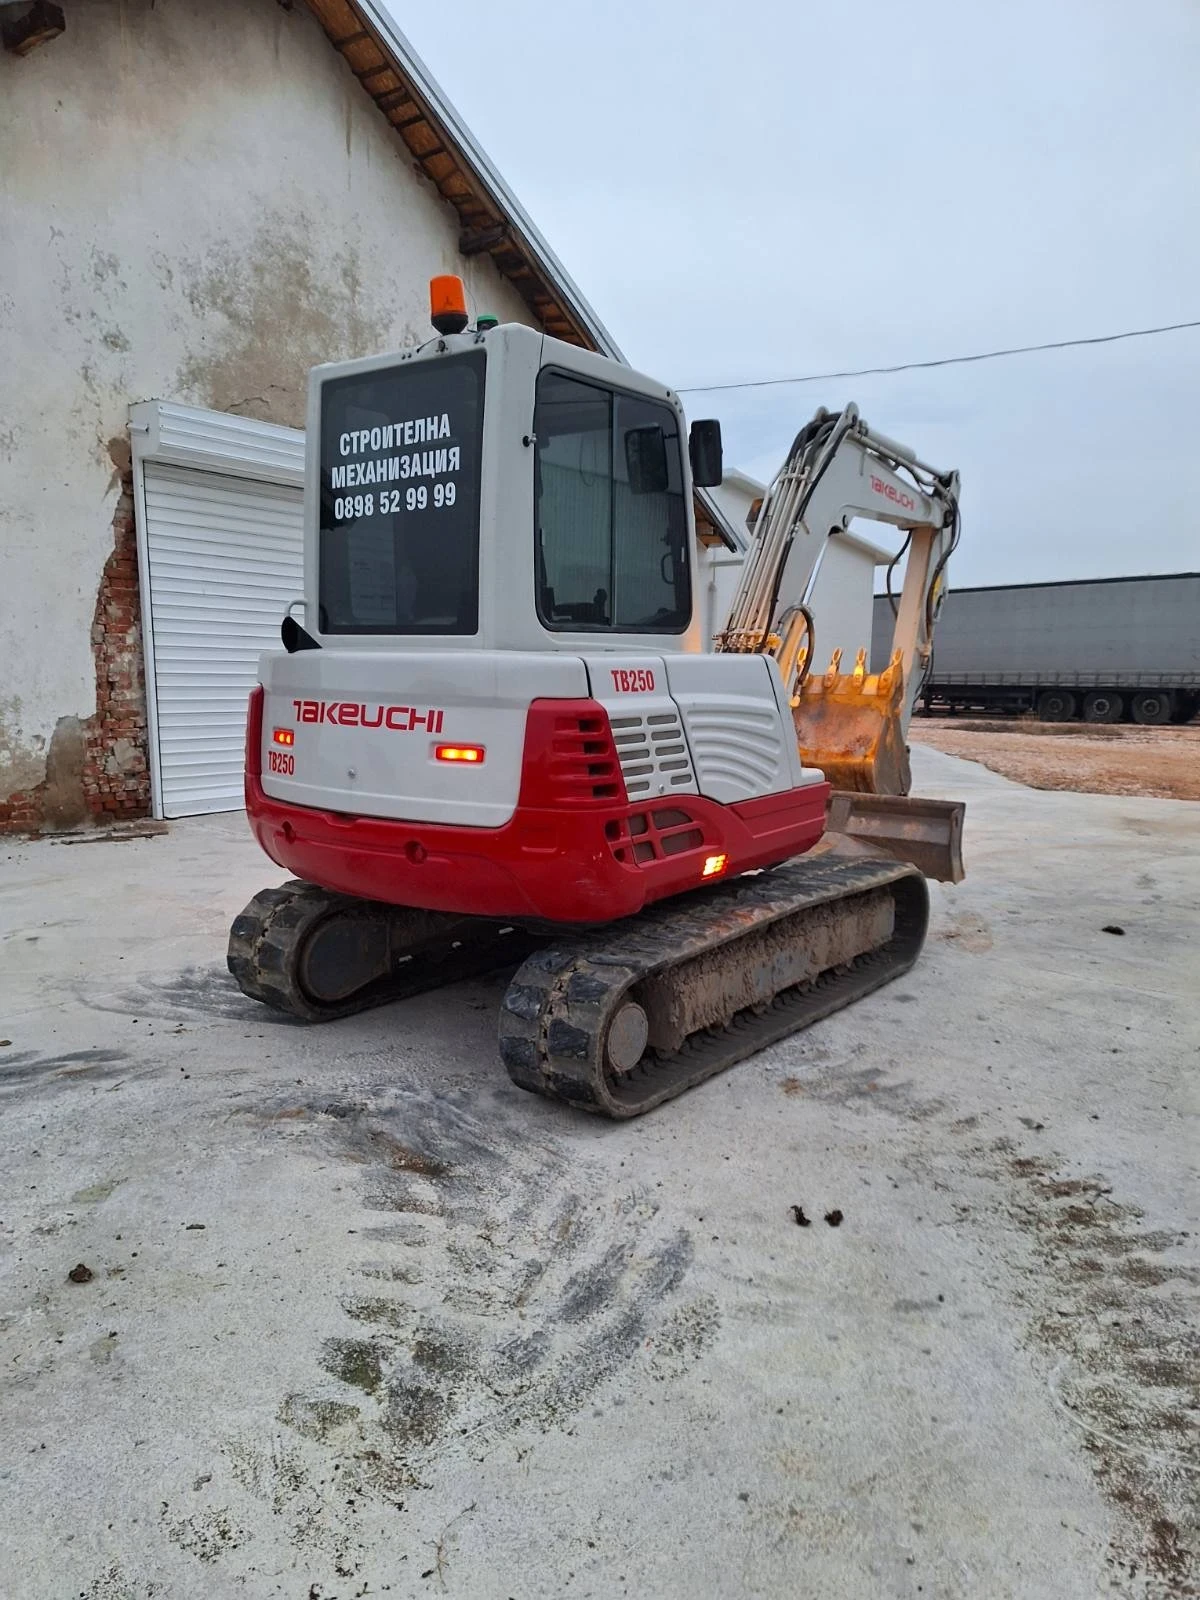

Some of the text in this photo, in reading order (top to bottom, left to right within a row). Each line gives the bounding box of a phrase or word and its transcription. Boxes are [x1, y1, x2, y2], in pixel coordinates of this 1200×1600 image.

[339, 413, 451, 456] СТРОИТЕЛНА
[331, 446, 460, 489] МЕХАНИЗАЦИЯ
[334, 481, 456, 519] 0898 52 99 99
[611, 669, 655, 692] TB250
[268, 750, 295, 776] TB250
